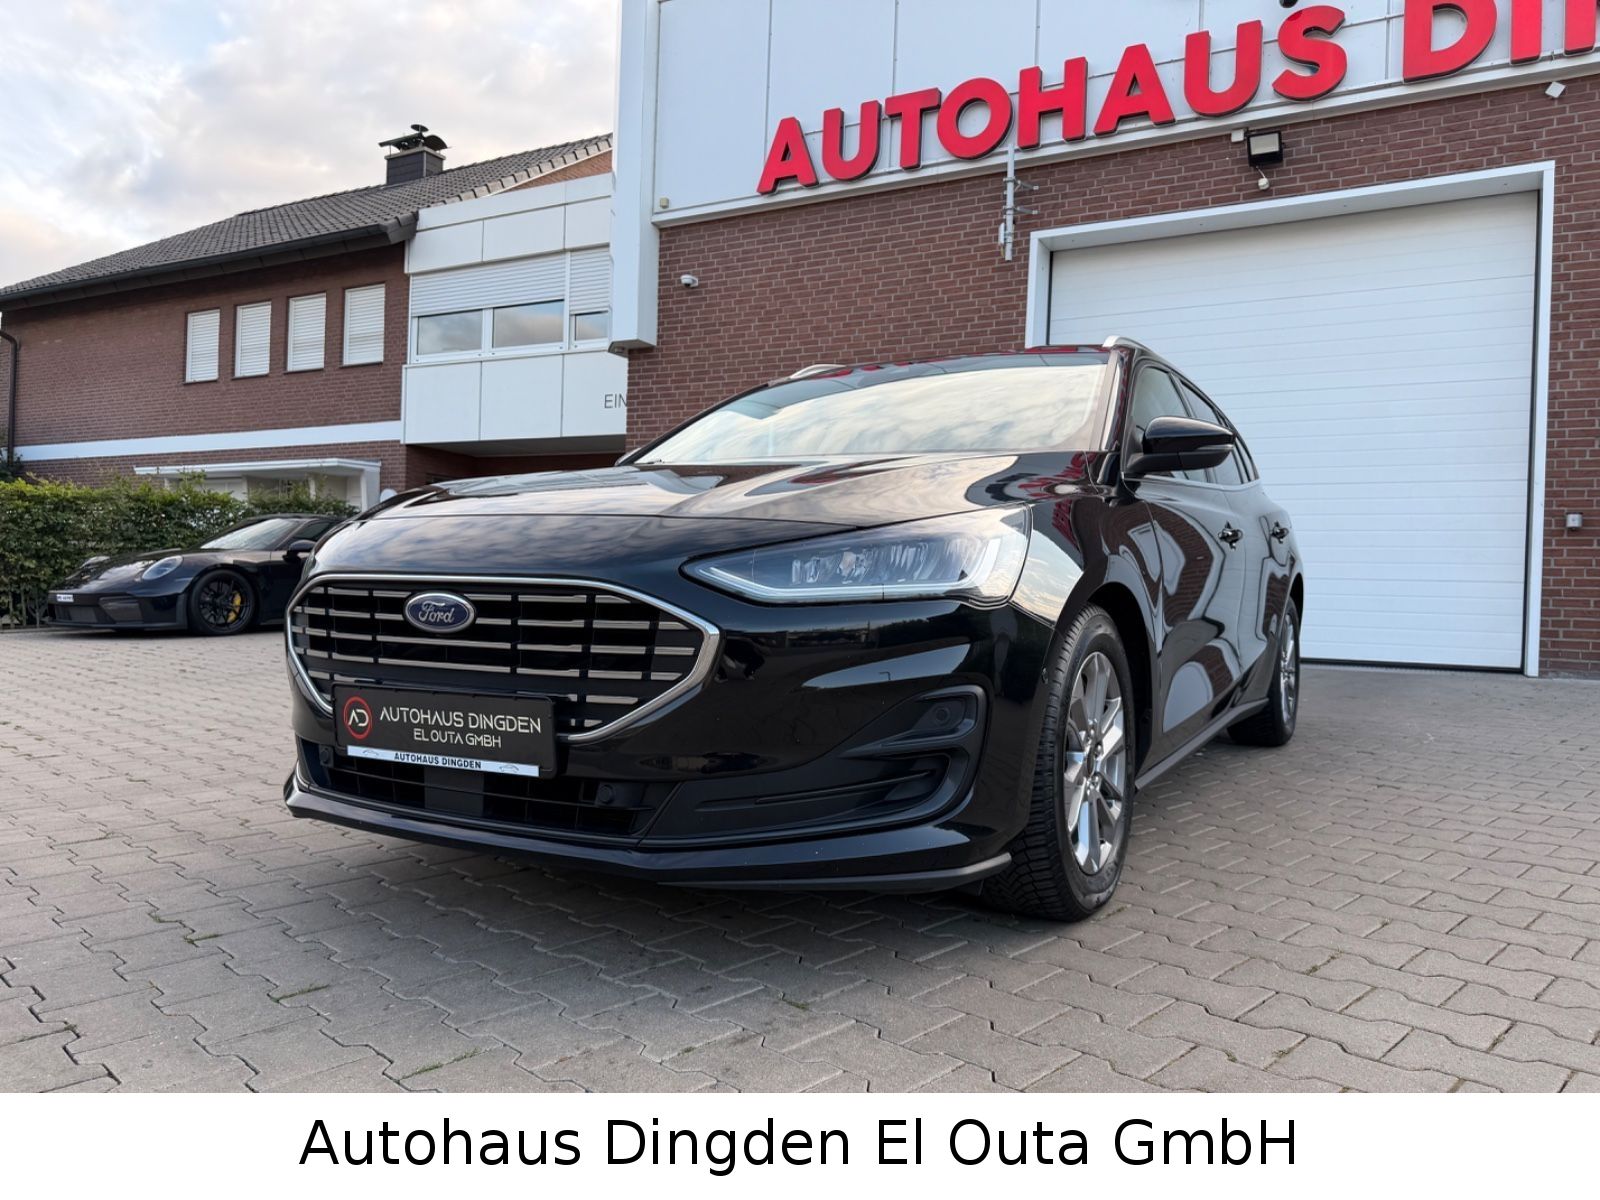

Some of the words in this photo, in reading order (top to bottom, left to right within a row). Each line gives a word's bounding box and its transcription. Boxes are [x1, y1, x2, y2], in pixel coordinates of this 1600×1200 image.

[757, 6, 1348, 194] AUTOHAUS
[418, 601, 455, 623] Ford
[379, 706, 464, 728] AUTOHAUS
[468, 712, 542, 734] DINGDEN
[413, 728, 429, 741] EL
[430, 729, 463, 745] OUTA
[465, 733, 502, 749] GMBH
[394, 752, 440, 766] AUTOHAUS
[441, 756, 482, 770] DINGDEN
